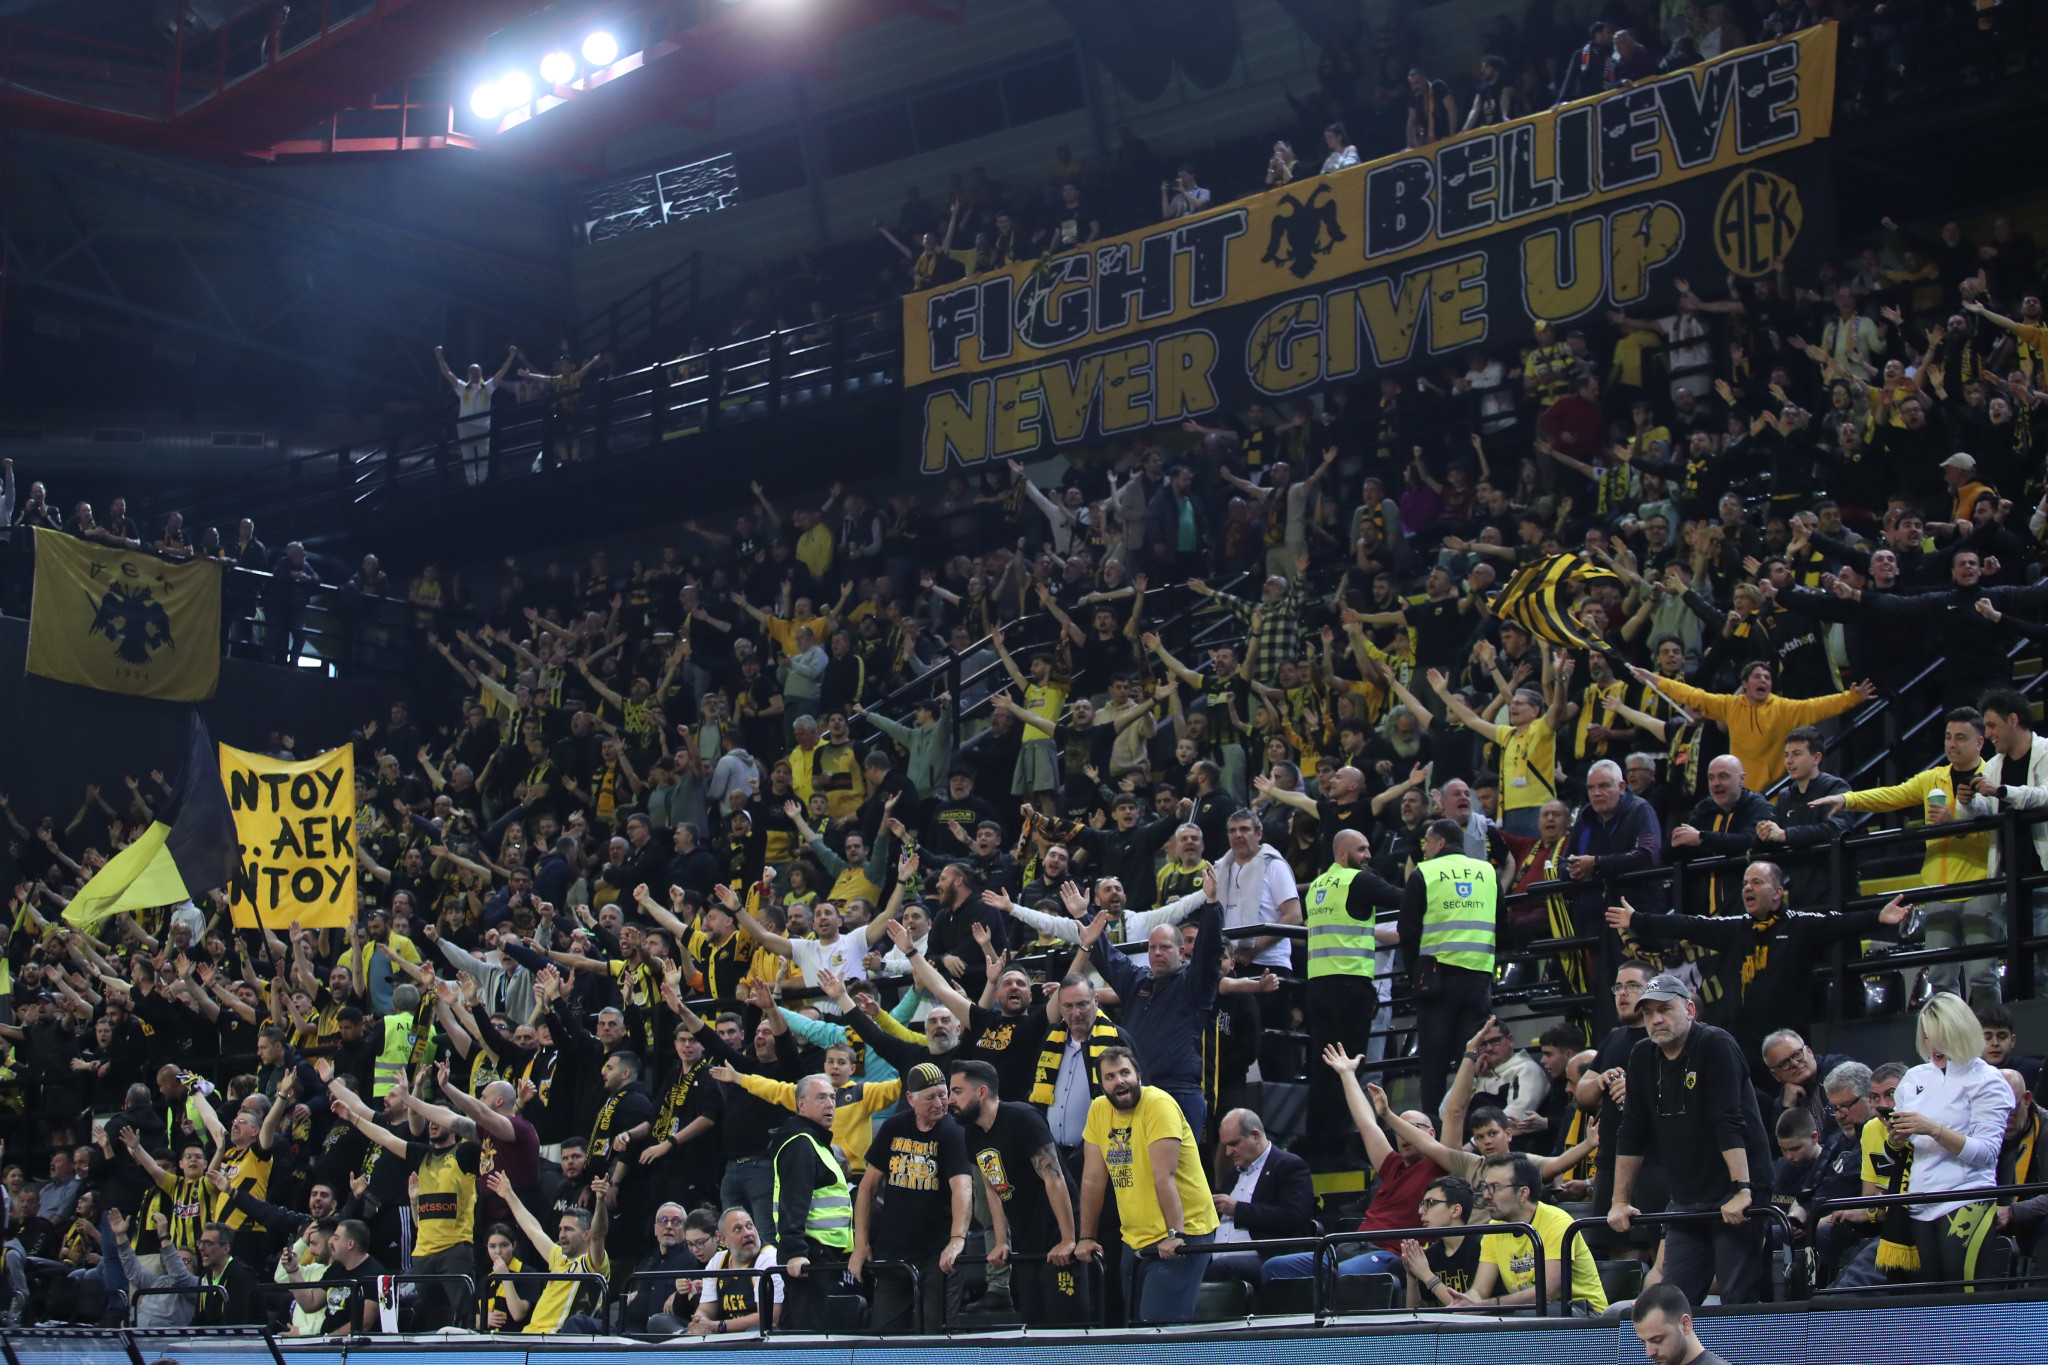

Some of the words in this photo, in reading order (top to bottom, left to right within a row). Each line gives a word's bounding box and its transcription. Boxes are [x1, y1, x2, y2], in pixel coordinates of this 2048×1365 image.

[927, 208, 1250, 376] FIGHT
[1364, 40, 1801, 260] BELIEVE
[1718, 172, 1797, 272] AEK
[920, 328, 1219, 474] NEVER
[1245, 251, 1489, 397] GIVE
[1519, 200, 1685, 326] UP
[1311, 876, 1340, 890] ALFA
[1439, 868, 1485, 882] ALFA
[1443, 901, 1485, 910] SECURITY
